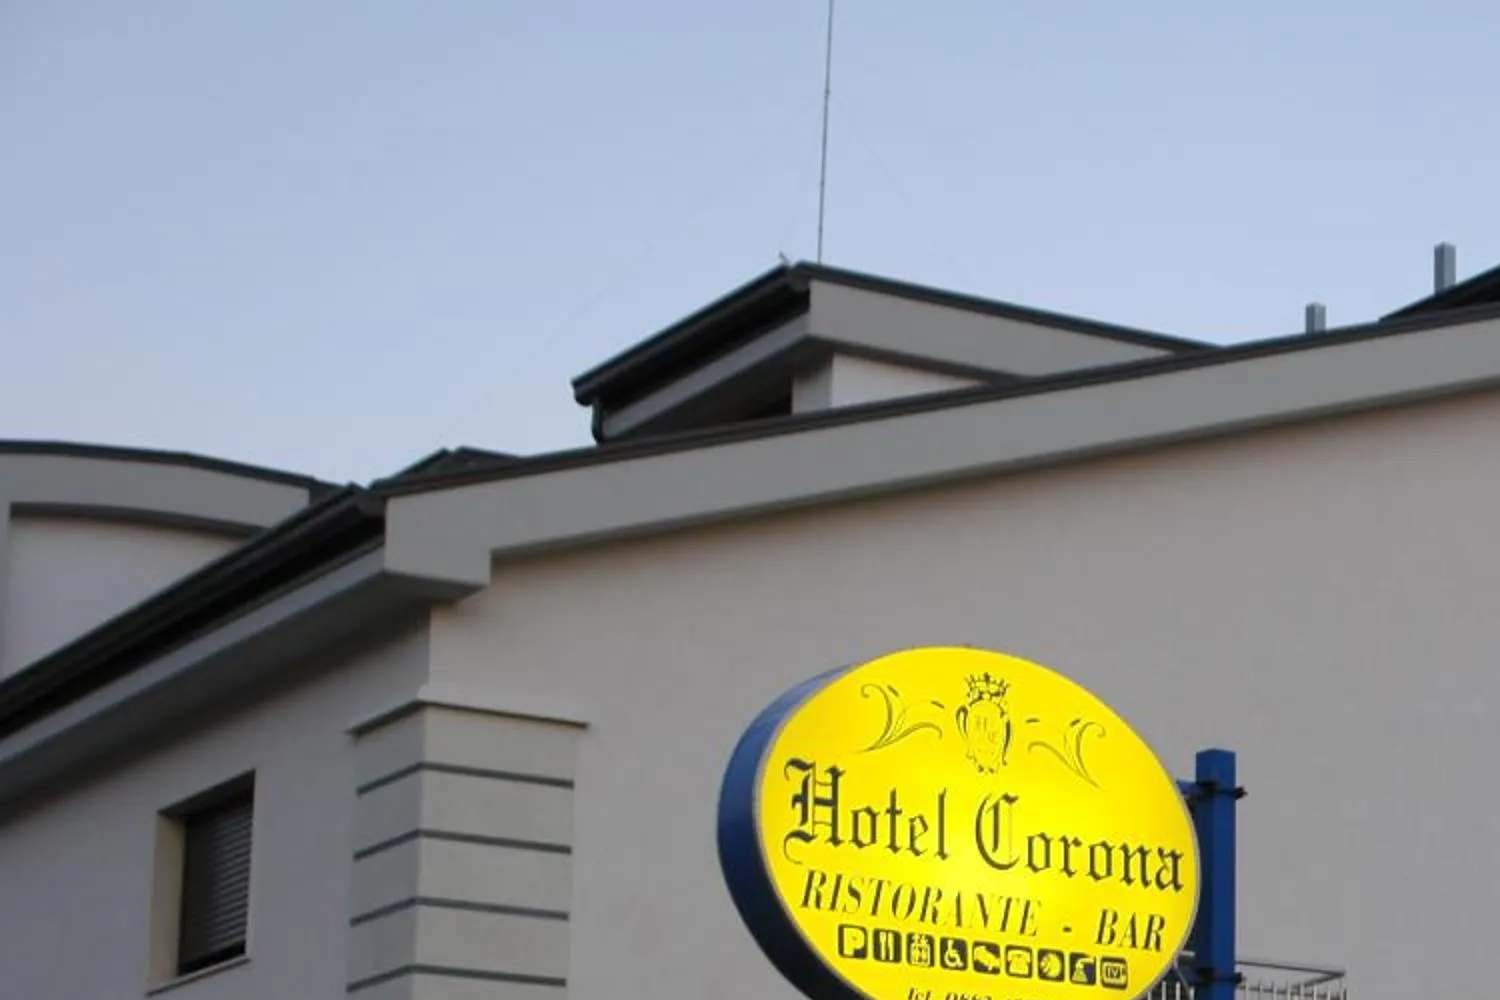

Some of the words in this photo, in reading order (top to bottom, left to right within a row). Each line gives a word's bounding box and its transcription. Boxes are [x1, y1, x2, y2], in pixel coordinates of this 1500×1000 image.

[783, 757, 949, 865] Hotel
[975, 792, 1184, 892] Corona
[801, 869, 1042, 937] RISTORANTE
[1095, 909, 1166, 953] BAR
